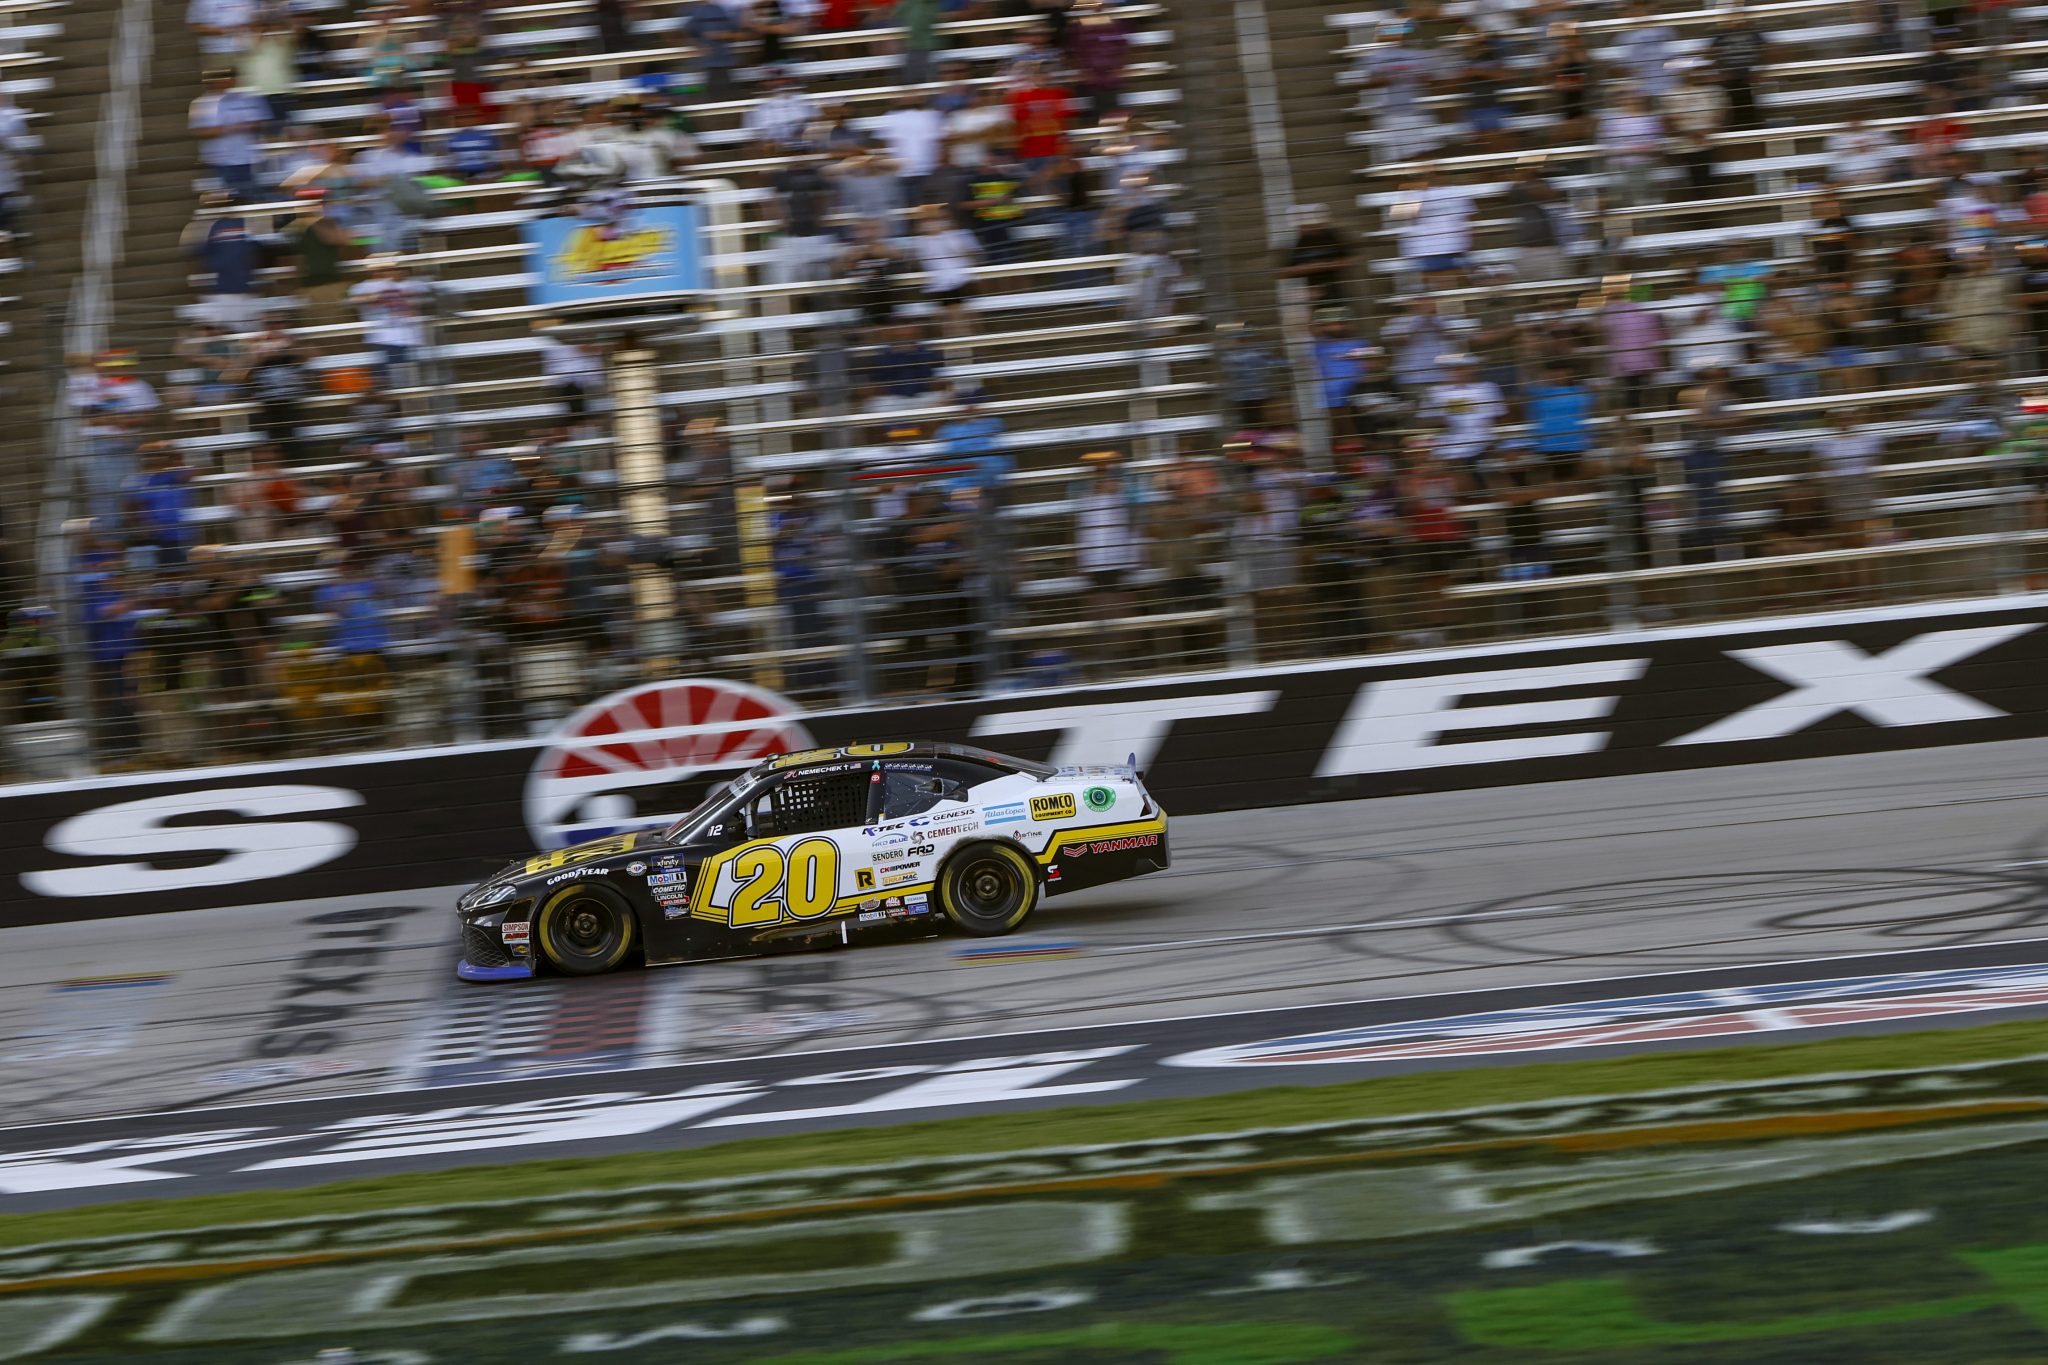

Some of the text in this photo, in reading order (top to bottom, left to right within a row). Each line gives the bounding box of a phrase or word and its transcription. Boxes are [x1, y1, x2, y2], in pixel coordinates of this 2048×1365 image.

[798, 765, 843, 776] NEMECHEK
[1033, 794, 1073, 812] ROMCO
[933, 808, 975, 821] GENESIS
[984, 807, 1026, 819] Atlas Copco
[1035, 811, 1064, 819] EQUIPMENT
[709, 824, 723, 837] 12
[862, 822, 905, 837] K-TEC
[927, 821, 979, 839] CEMENTECH
[889, 836, 909, 845] BLUE
[1090, 834, 1158, 855] YANMAR
[872, 849, 903, 862] SENDERO
[907, 843, 935, 857] FRD
[656, 858, 679, 867] xfinity
[895, 861, 920, 871] POWER
[546, 867, 610, 886] GOODYEAR
[649, 873, 674, 884] Mobil
[728, 835, 842, 930] 20
[857, 870, 874, 888] R
[652, 884, 686, 894] COMETIC
[656, 893, 683, 901] LINCOLN
[503, 923, 529, 931] SIMPSON
